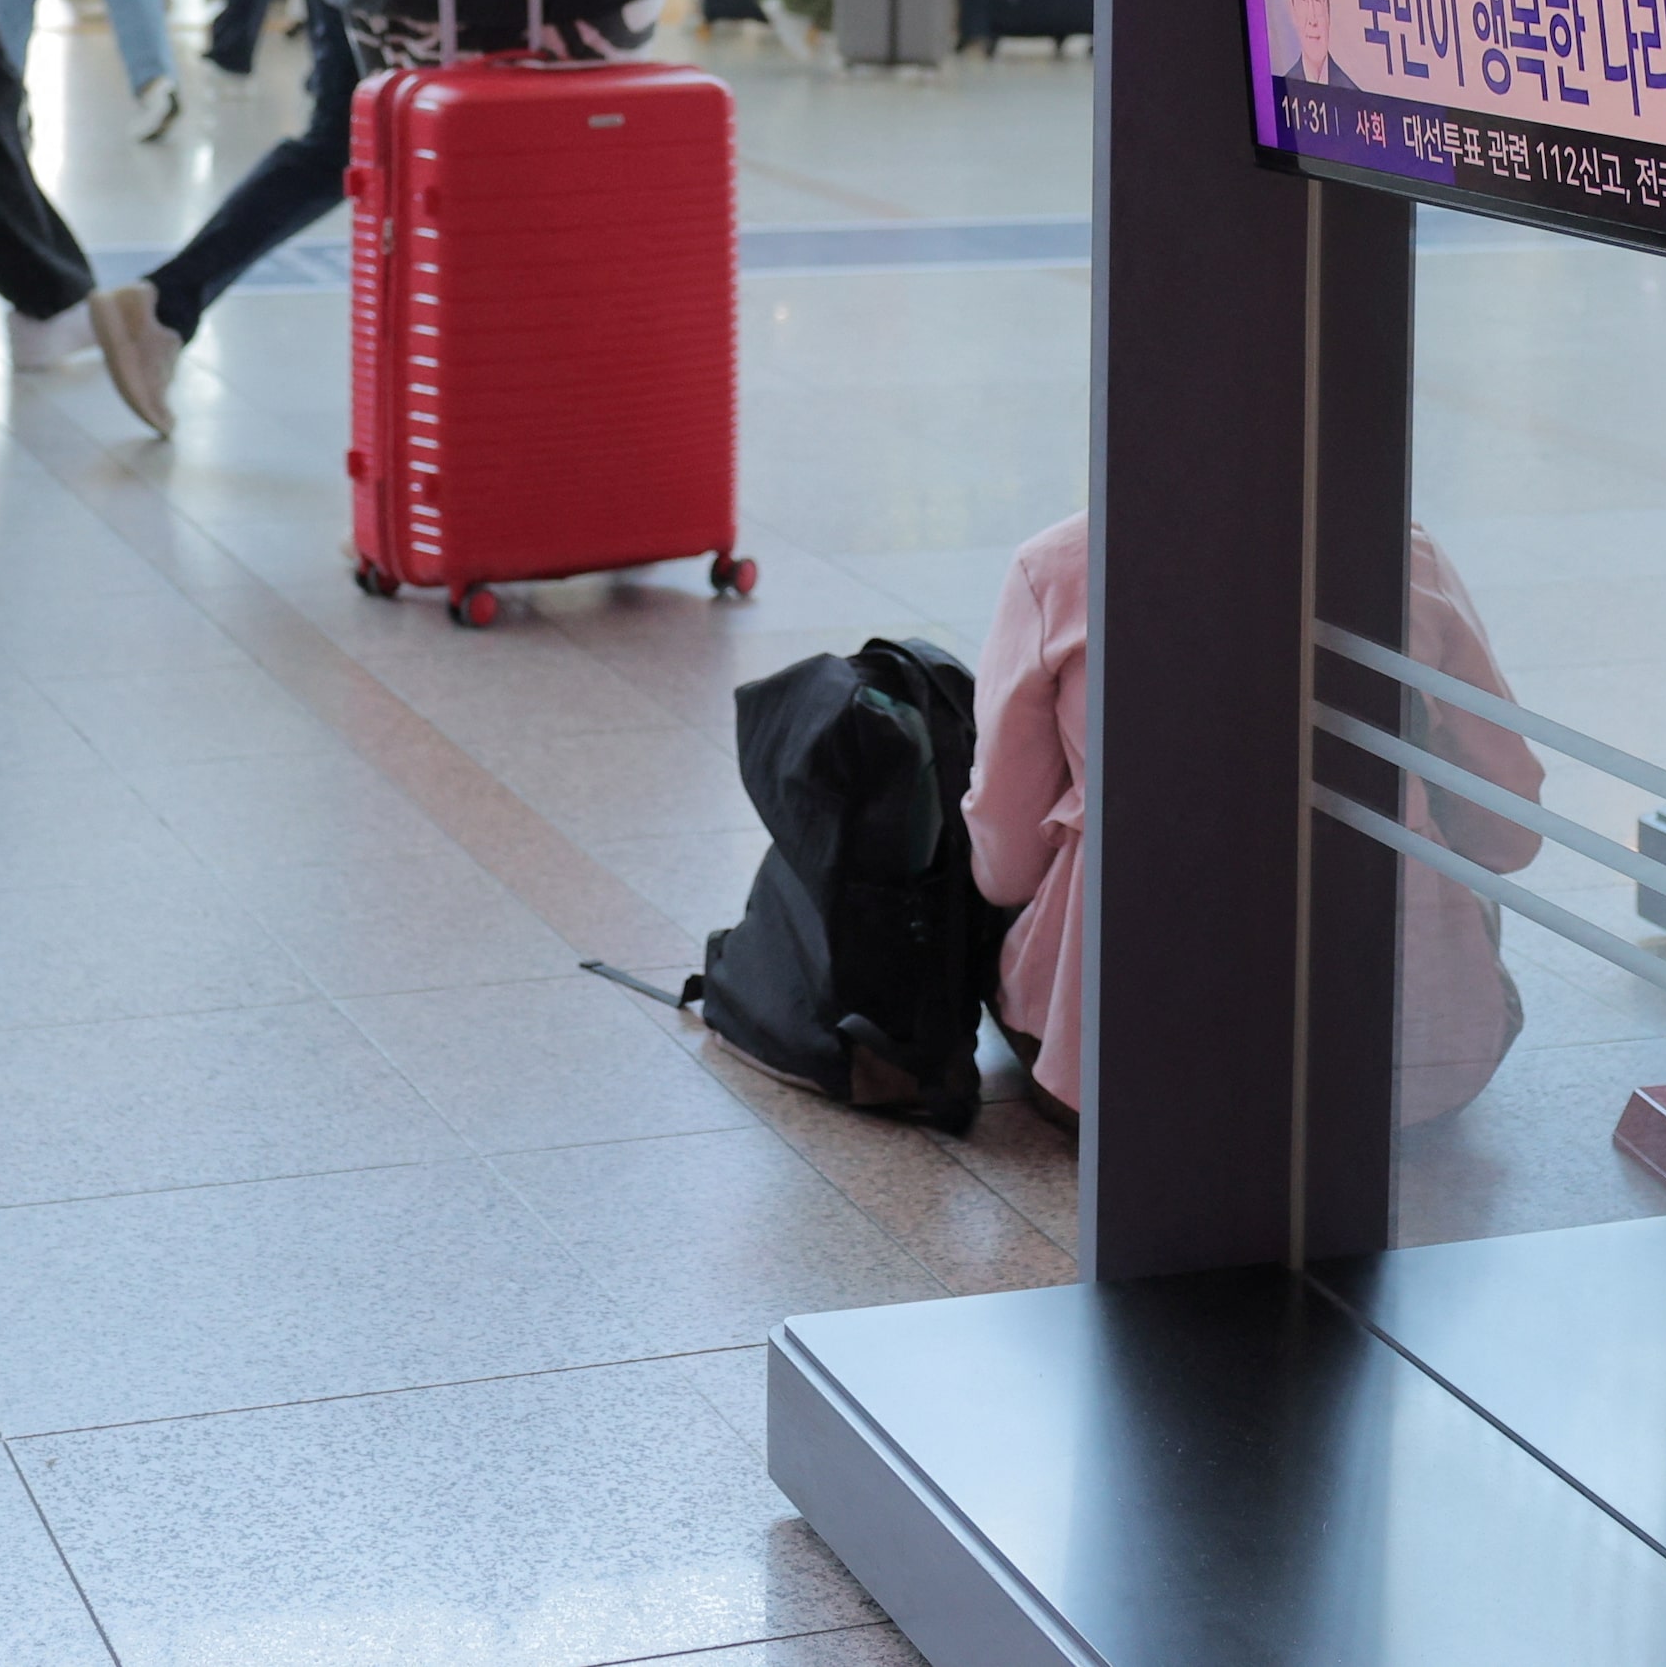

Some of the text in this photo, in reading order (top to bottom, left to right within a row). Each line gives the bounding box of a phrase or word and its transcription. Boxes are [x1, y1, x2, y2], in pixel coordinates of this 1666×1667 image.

[1281, 95, 1329, 136] 11:31
[1355, 109, 1387, 149] 사회
[1402, 114, 1485, 168] 대선투표
[1487, 129, 1533, 182] 관련
[1536, 140, 1632, 204] 112신고,
